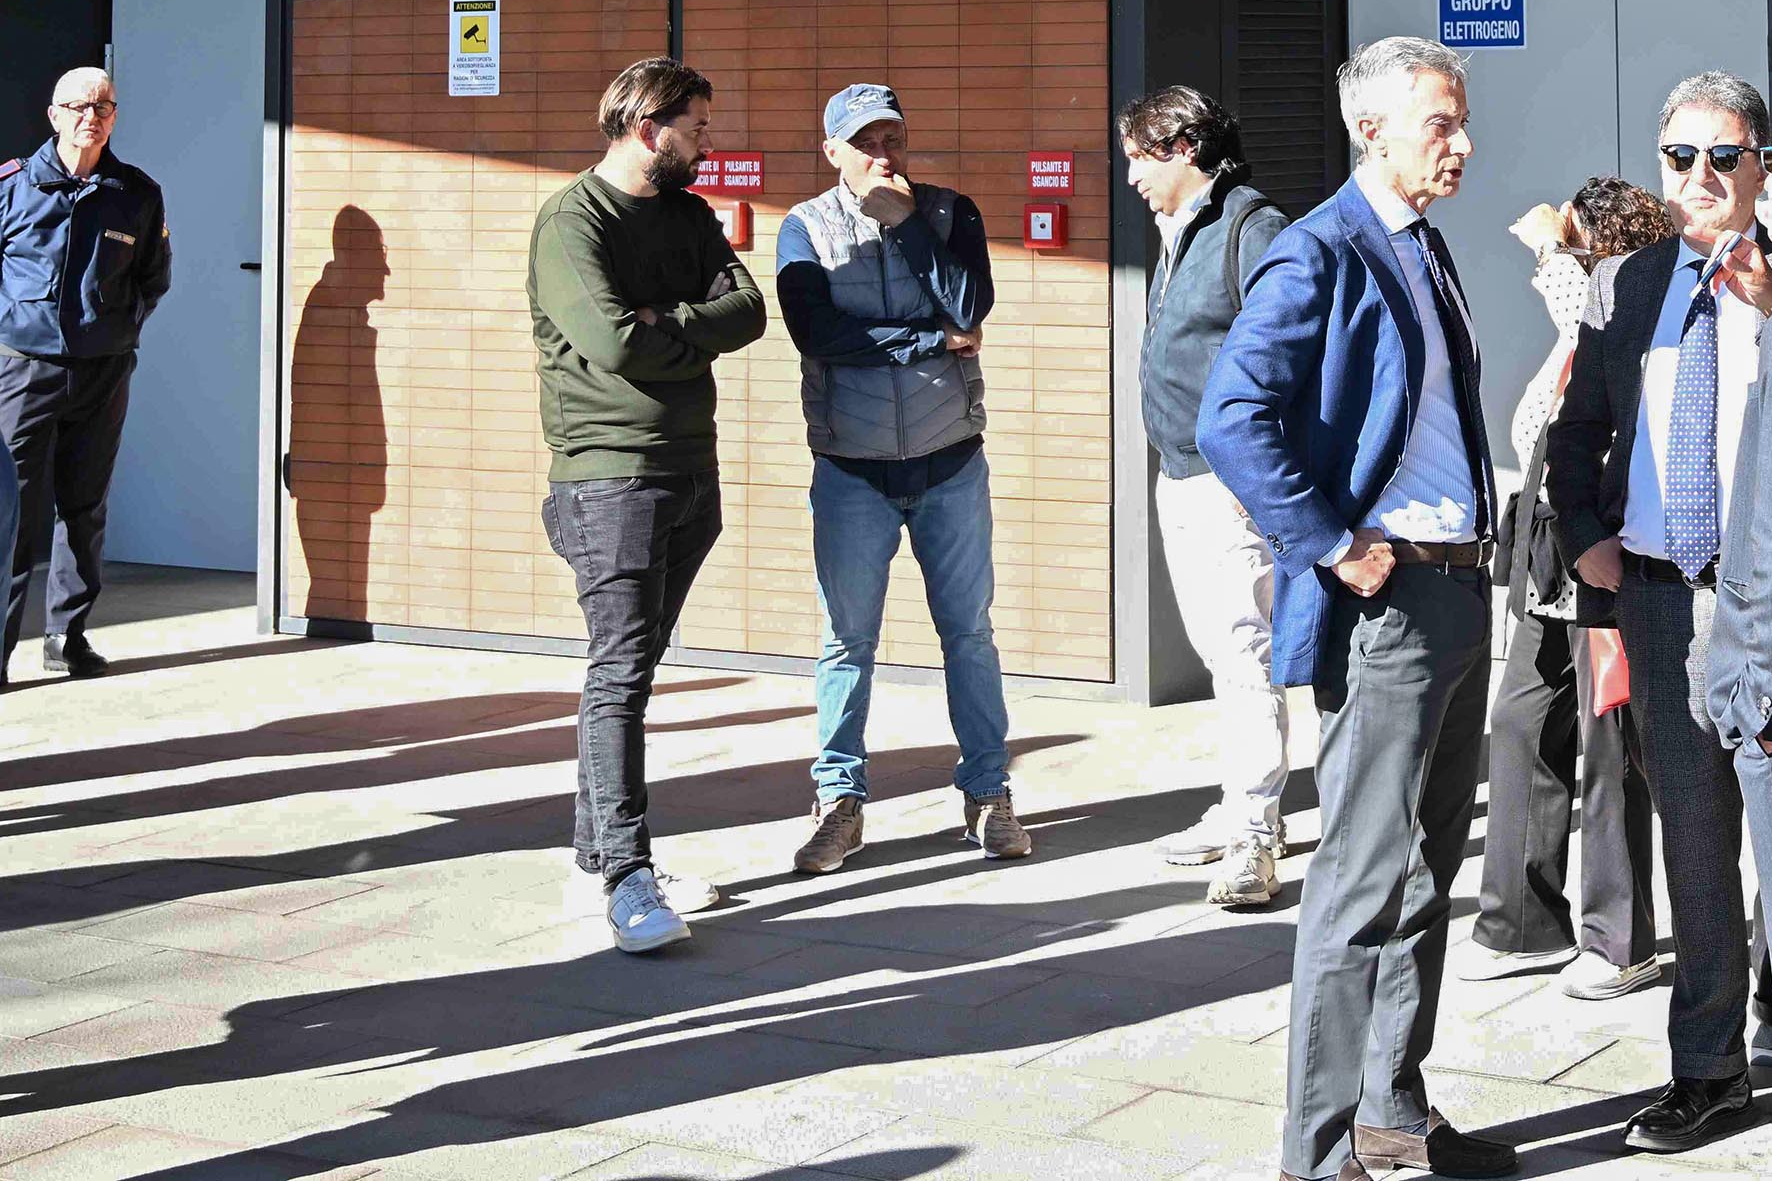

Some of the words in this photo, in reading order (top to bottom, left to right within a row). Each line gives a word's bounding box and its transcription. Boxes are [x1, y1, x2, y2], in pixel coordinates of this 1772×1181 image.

[456, 2, 494, 10] ATTENZIONE!
[1443, 20, 1520, 40] ELETTROGENO
[698, 161, 712, 172] ANTE
[713, 161, 719, 172] DI
[725, 161, 752, 172] PULSANTE
[753, 161, 760, 172] DI
[1031, 161, 1062, 173] PULSANTE
[1063, 161, 1070, 173] DI
[709, 175, 719, 186] MT
[725, 175, 748, 186] SGANCIO
[749, 175, 760, 186] UPS
[1032, 175, 1059, 188] SGANCIO
[1060, 175, 1069, 188] GE
